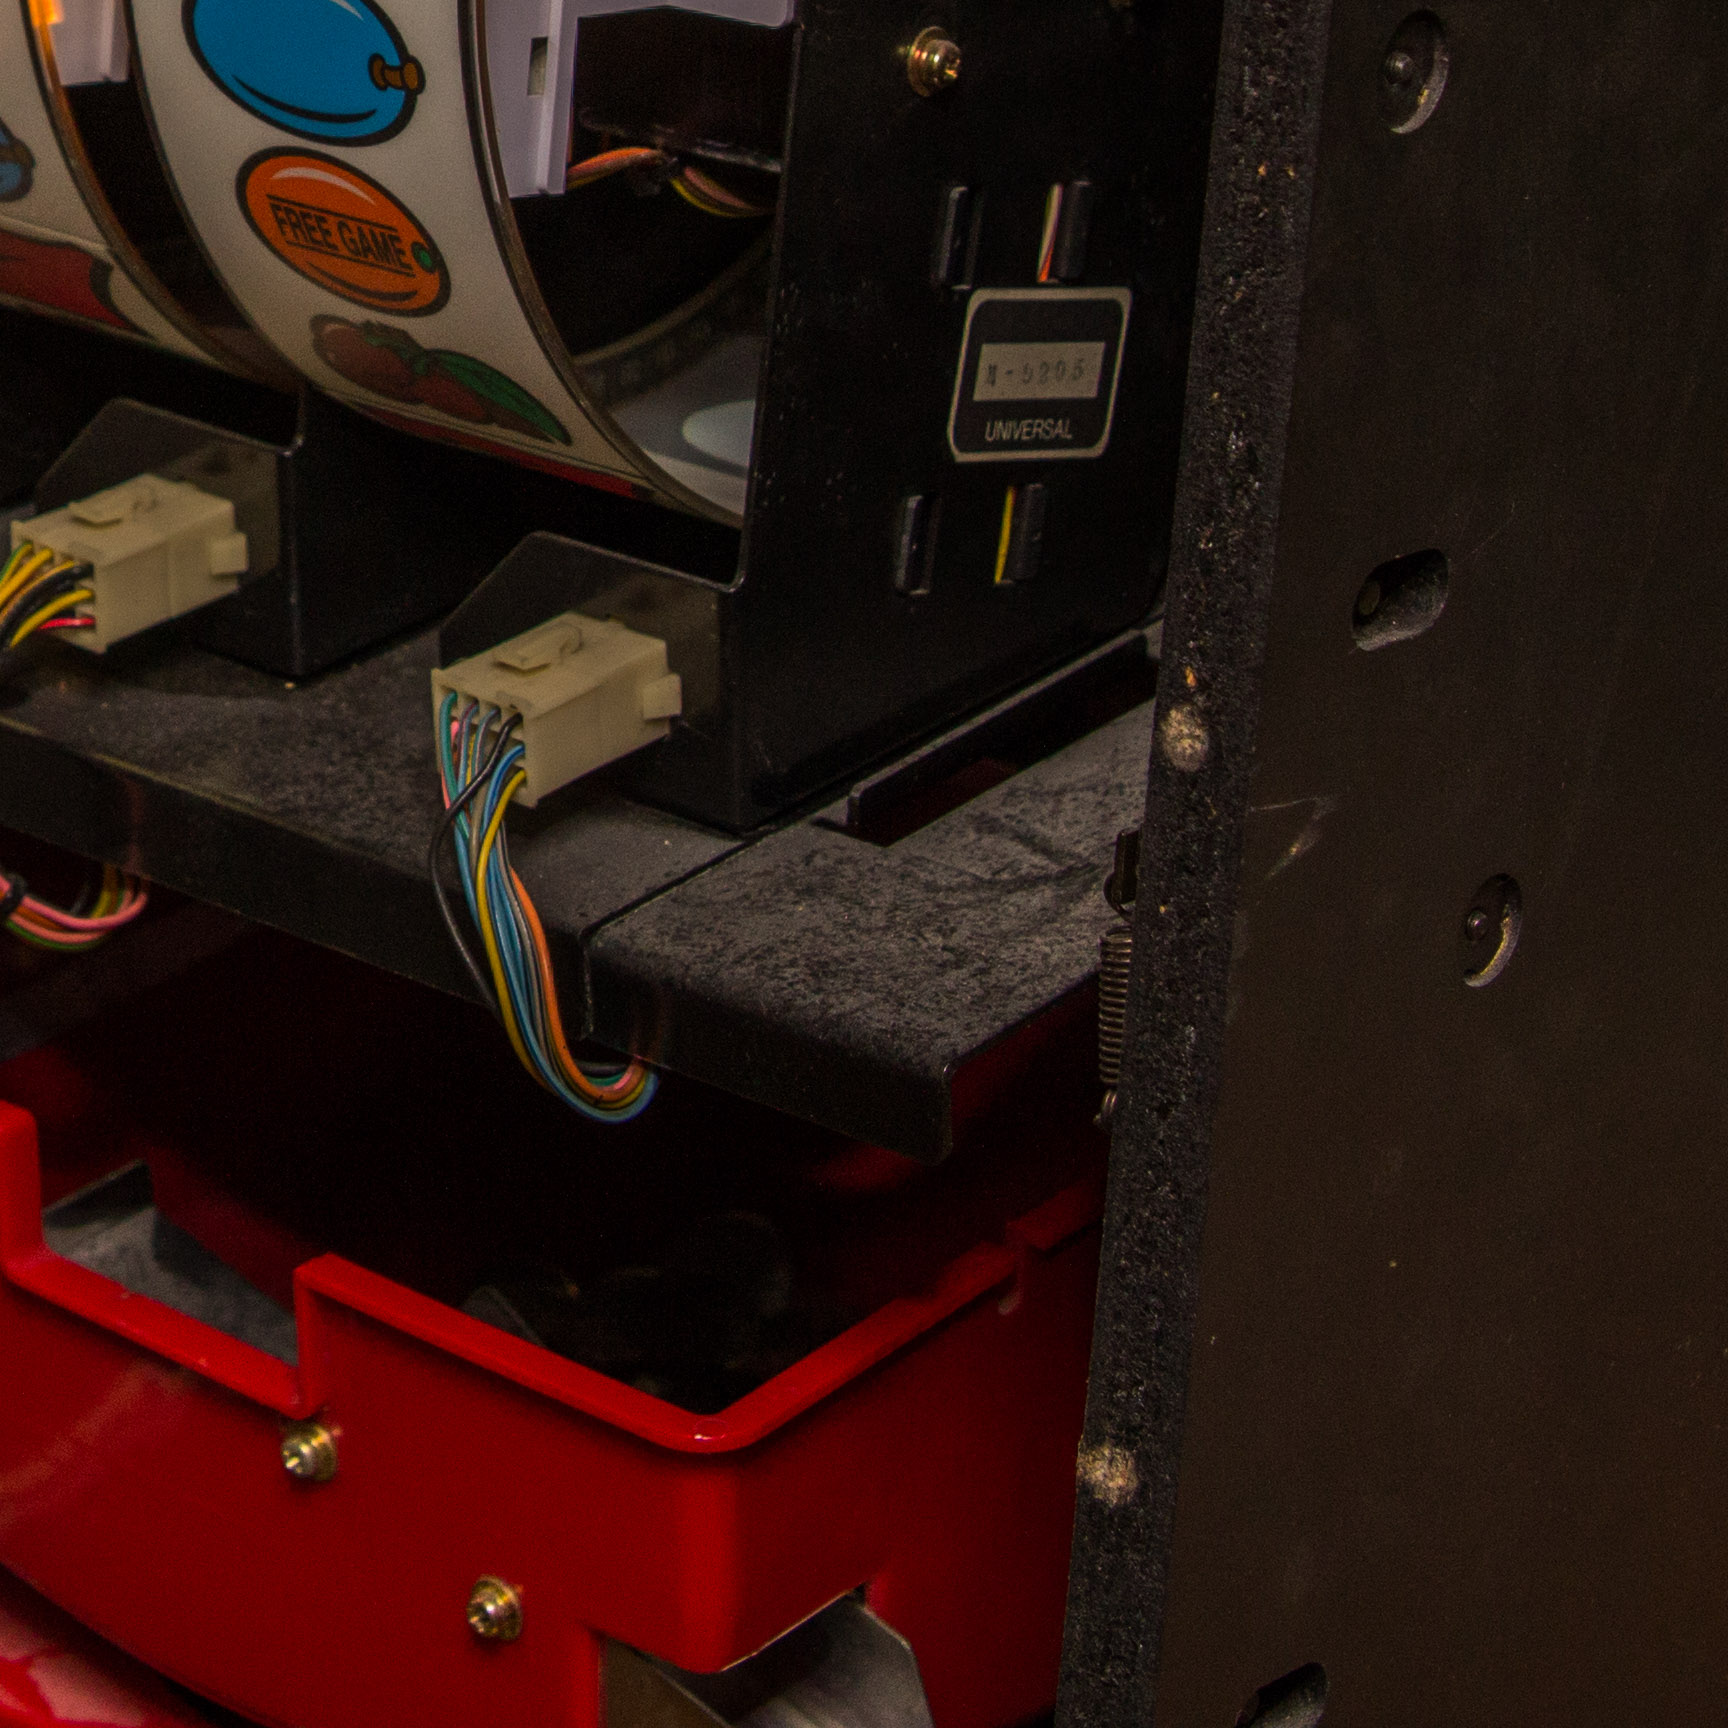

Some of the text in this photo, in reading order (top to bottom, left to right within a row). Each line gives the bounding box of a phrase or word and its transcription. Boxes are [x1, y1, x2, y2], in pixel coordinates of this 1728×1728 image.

[269, 202, 414, 271] FREE GAME
[984, 418, 1073, 442] UNIVERSAL
